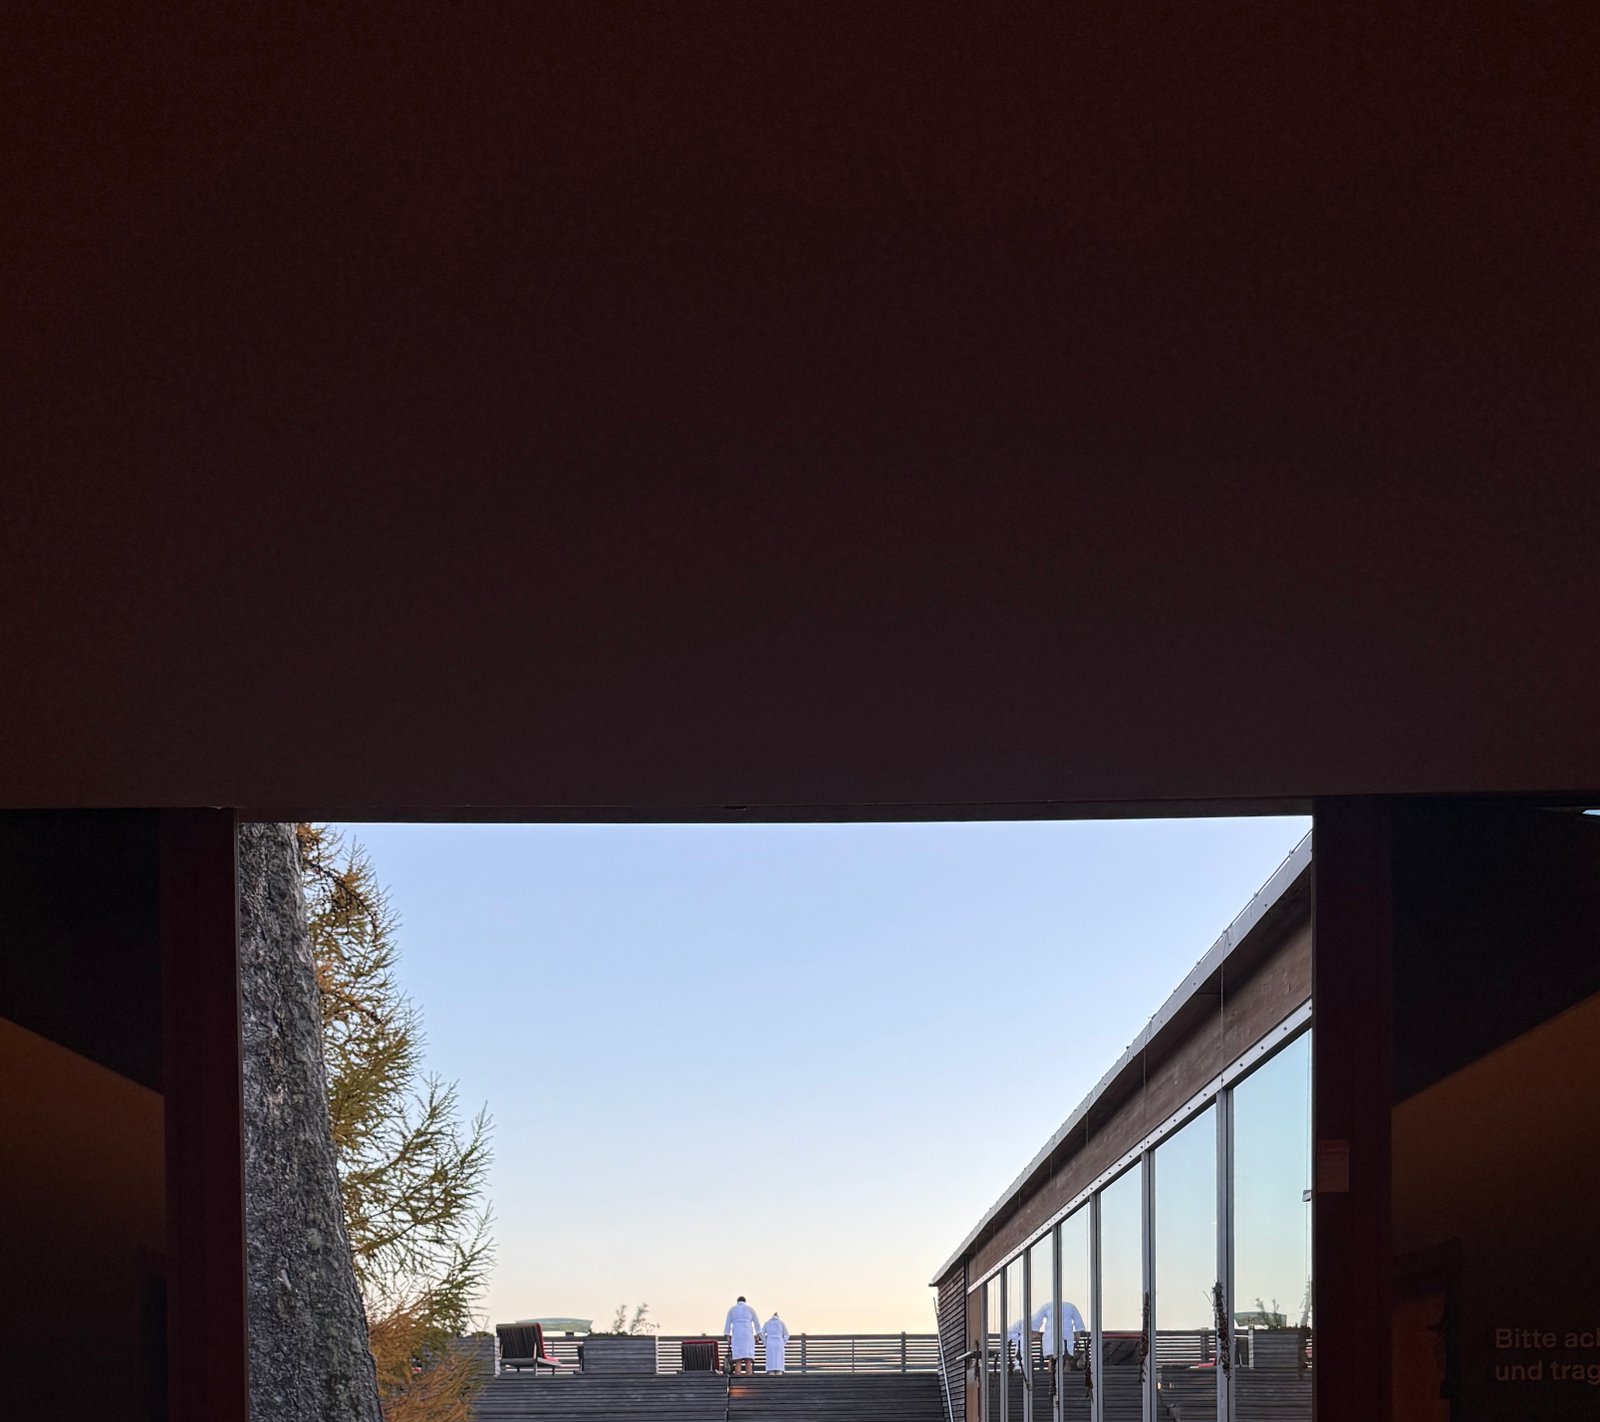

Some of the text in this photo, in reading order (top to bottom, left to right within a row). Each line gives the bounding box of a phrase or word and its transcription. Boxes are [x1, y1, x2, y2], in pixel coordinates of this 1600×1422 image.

[1495, 1328, 1557, 1348] Bitte
[1495, 1360, 1600, 1386] und trag
